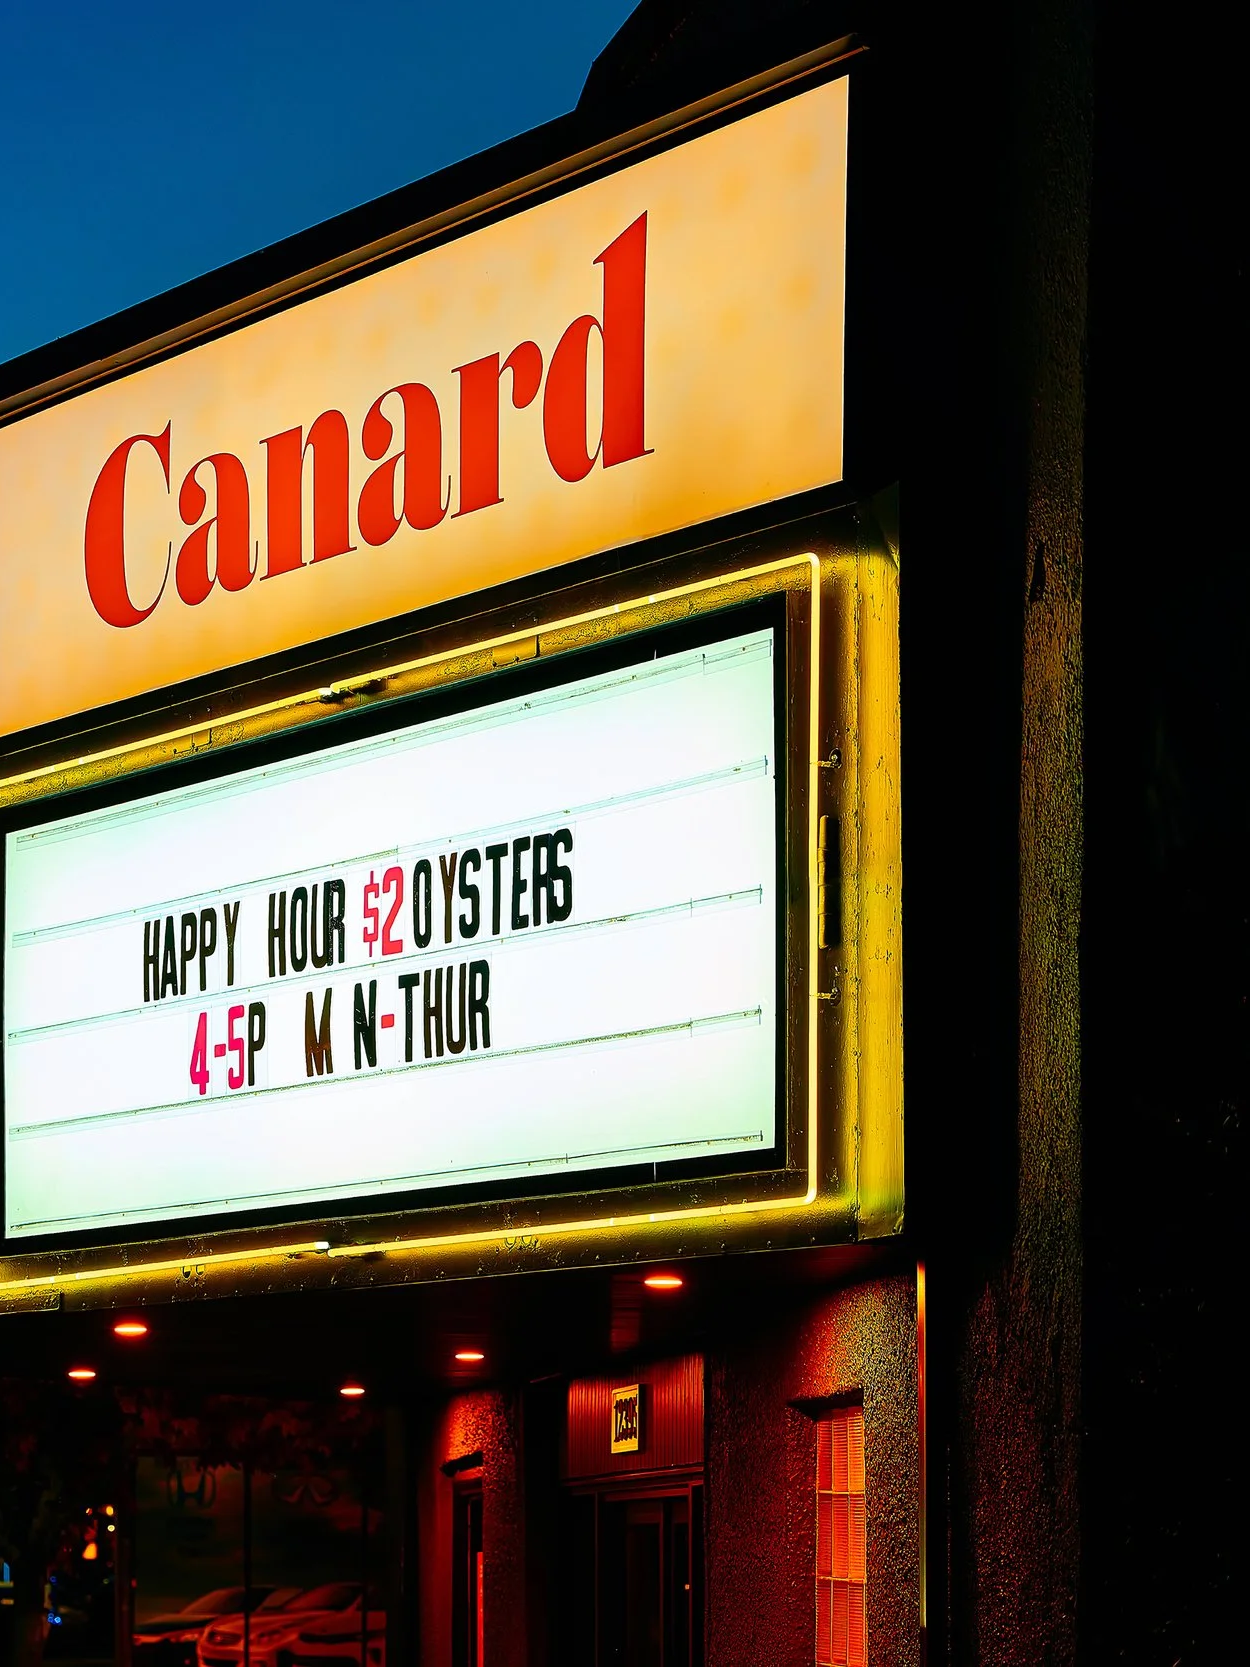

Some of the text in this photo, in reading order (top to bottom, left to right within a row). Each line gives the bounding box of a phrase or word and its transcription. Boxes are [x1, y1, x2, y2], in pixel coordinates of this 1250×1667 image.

[85, 210, 654, 627] Canard
[143, 828, 573, 1002] HAPPY HOUR $2 OYSTERS
